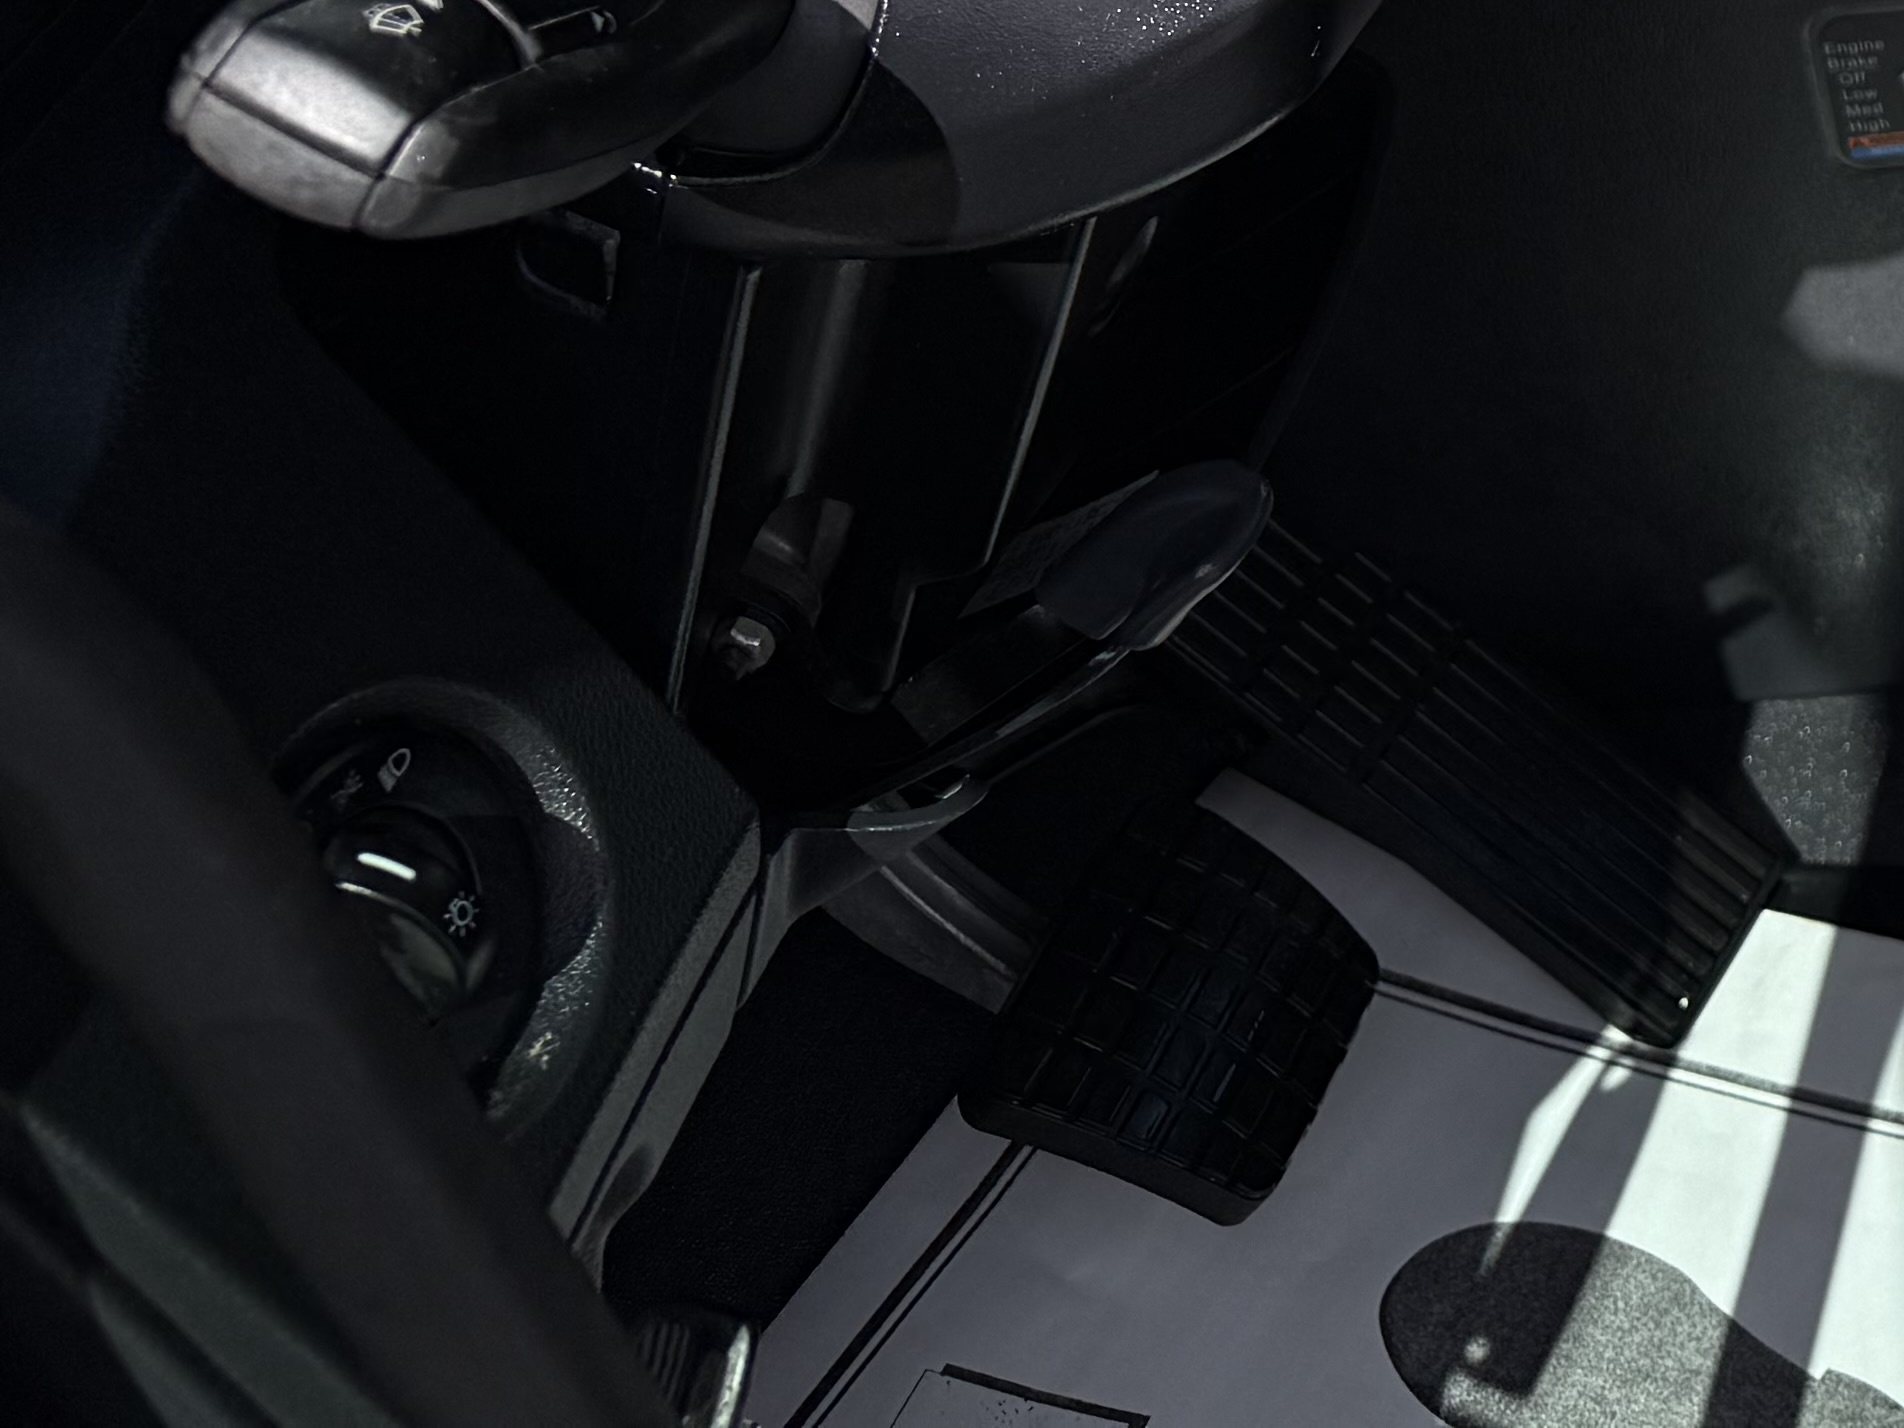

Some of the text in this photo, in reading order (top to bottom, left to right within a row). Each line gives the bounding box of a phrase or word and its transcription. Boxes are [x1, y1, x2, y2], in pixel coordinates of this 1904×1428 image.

[1824, 39, 1885, 55] Engine
[1827, 56, 1878, 70] Brake
[1839, 71, 1866, 85] Off
[1842, 89, 1878, 101] Low
[1846, 102, 1884, 117] Med
[1849, 118, 1891, 132] High
